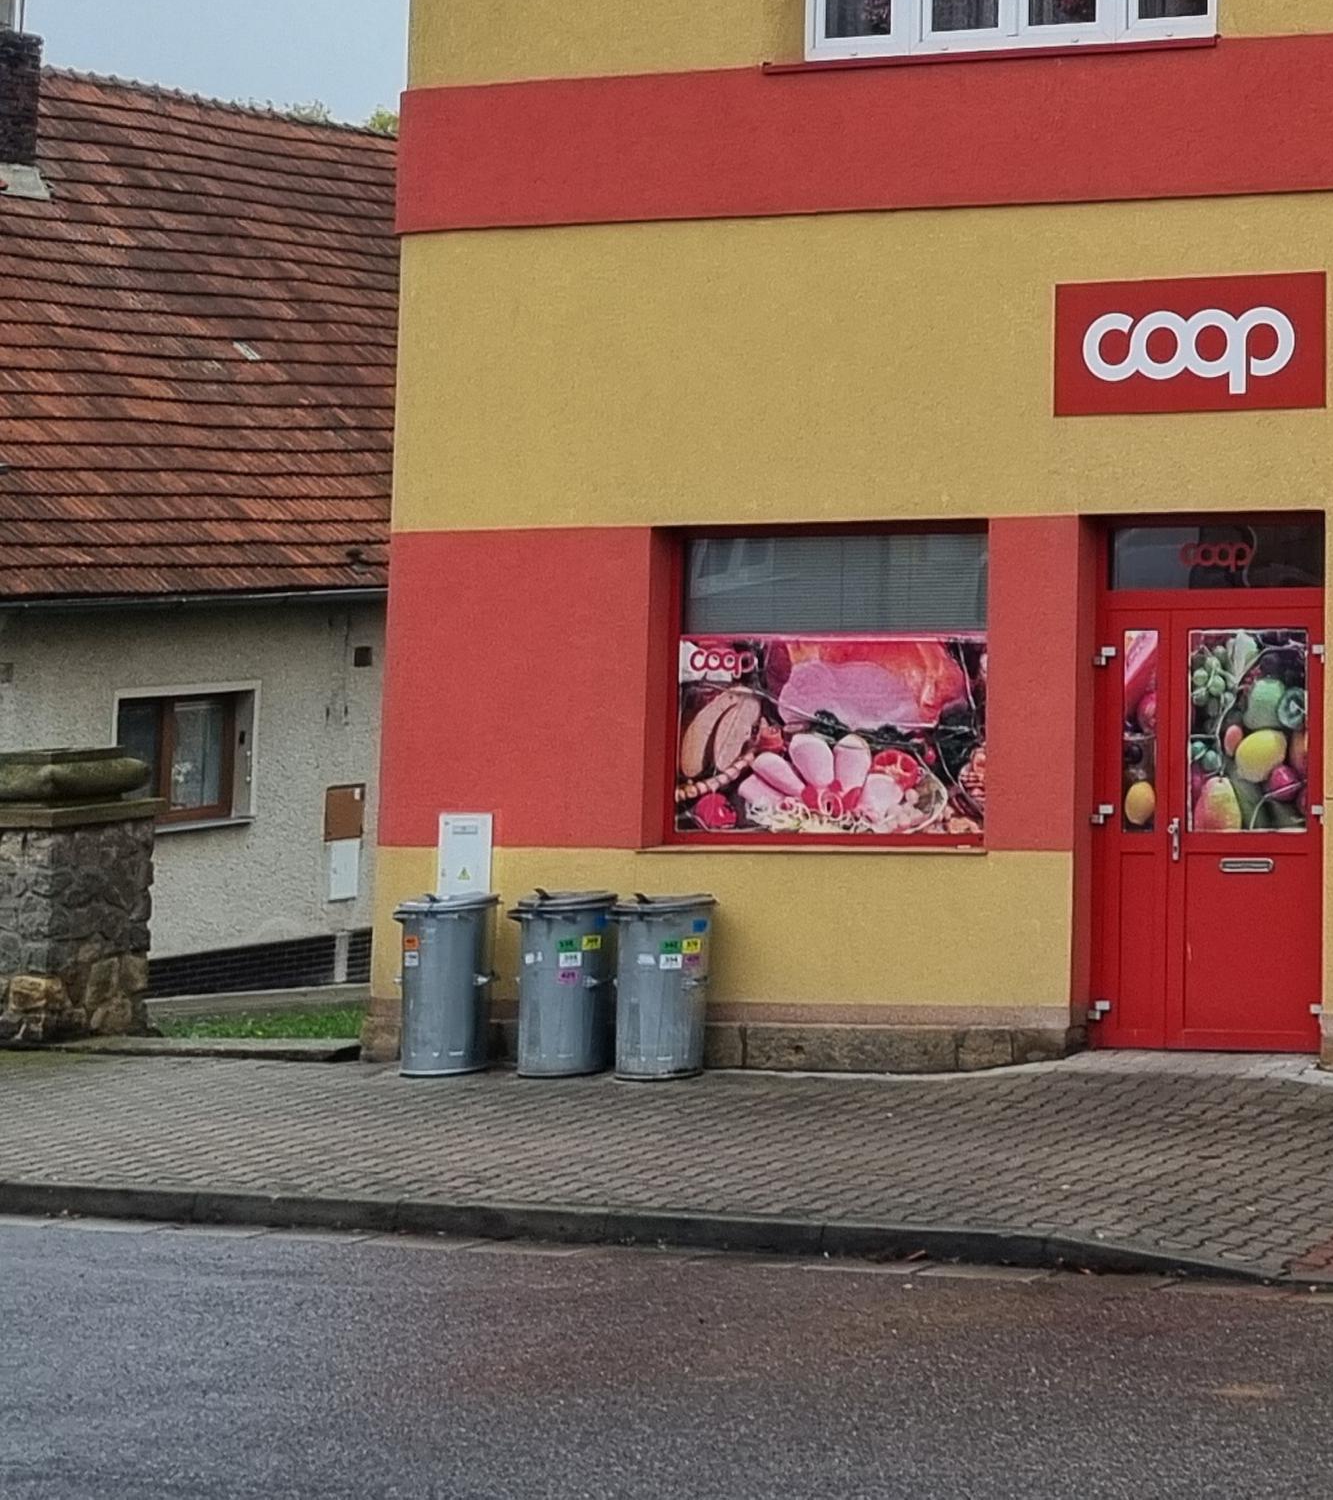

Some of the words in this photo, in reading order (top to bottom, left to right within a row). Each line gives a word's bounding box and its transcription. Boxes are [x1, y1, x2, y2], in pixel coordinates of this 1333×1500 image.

[1083, 306, 1296, 395] coop
[1179, 542, 1253, 572] coop
[689, 649, 757, 679] coop
